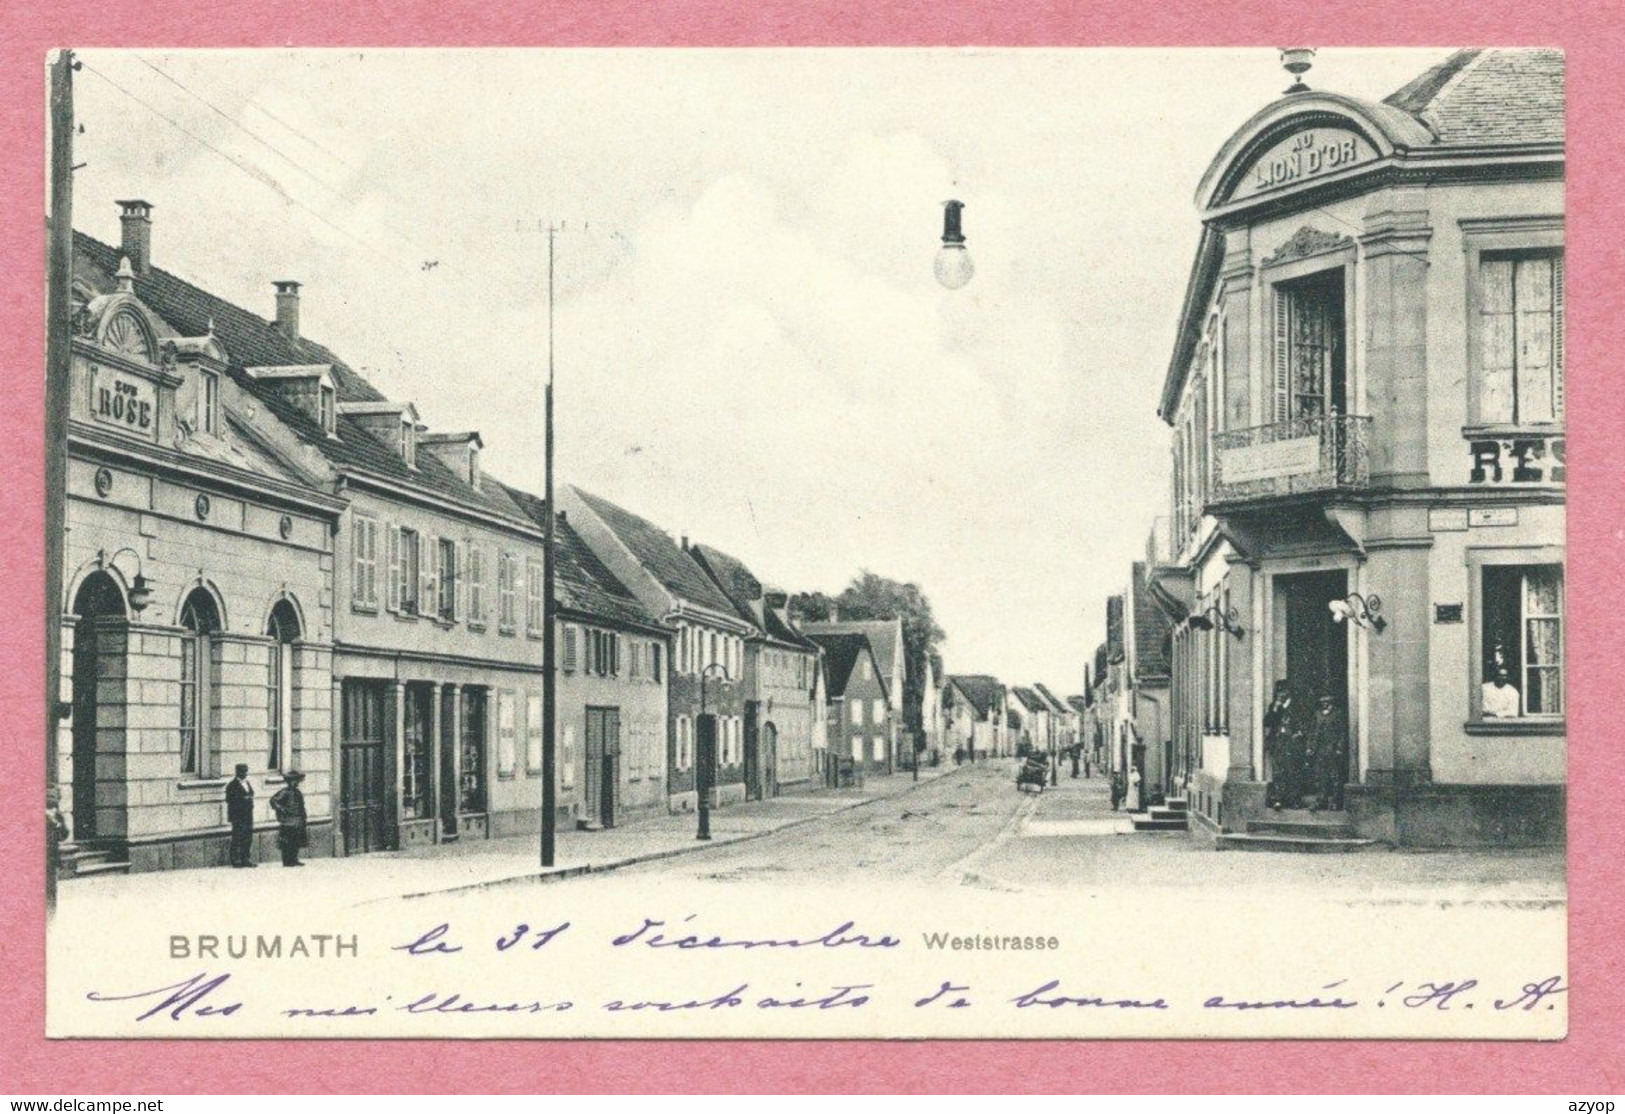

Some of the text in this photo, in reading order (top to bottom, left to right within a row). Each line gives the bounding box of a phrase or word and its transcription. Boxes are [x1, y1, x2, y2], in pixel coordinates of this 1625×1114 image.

[1292, 133, 1314, 153] AU
[1256, 137, 1357, 189] LION D'OR
[114, 379, 139, 397] ZUR
[99, 386, 152, 429] ROSE
[169, 935, 359, 958] BRUMATH
[391, 923, 463, 954] le
[612, 913, 901, 949] décembre
[922, 932, 1060, 951] Weststrasse
[86, 973, 243, 1021] Mes
[281, 994, 575, 1018] meilleurs
[602, 983, 875, 1012] souhaits
[914, 981, 971, 1008] de
[1012, 979, 1170, 1010] bonne
